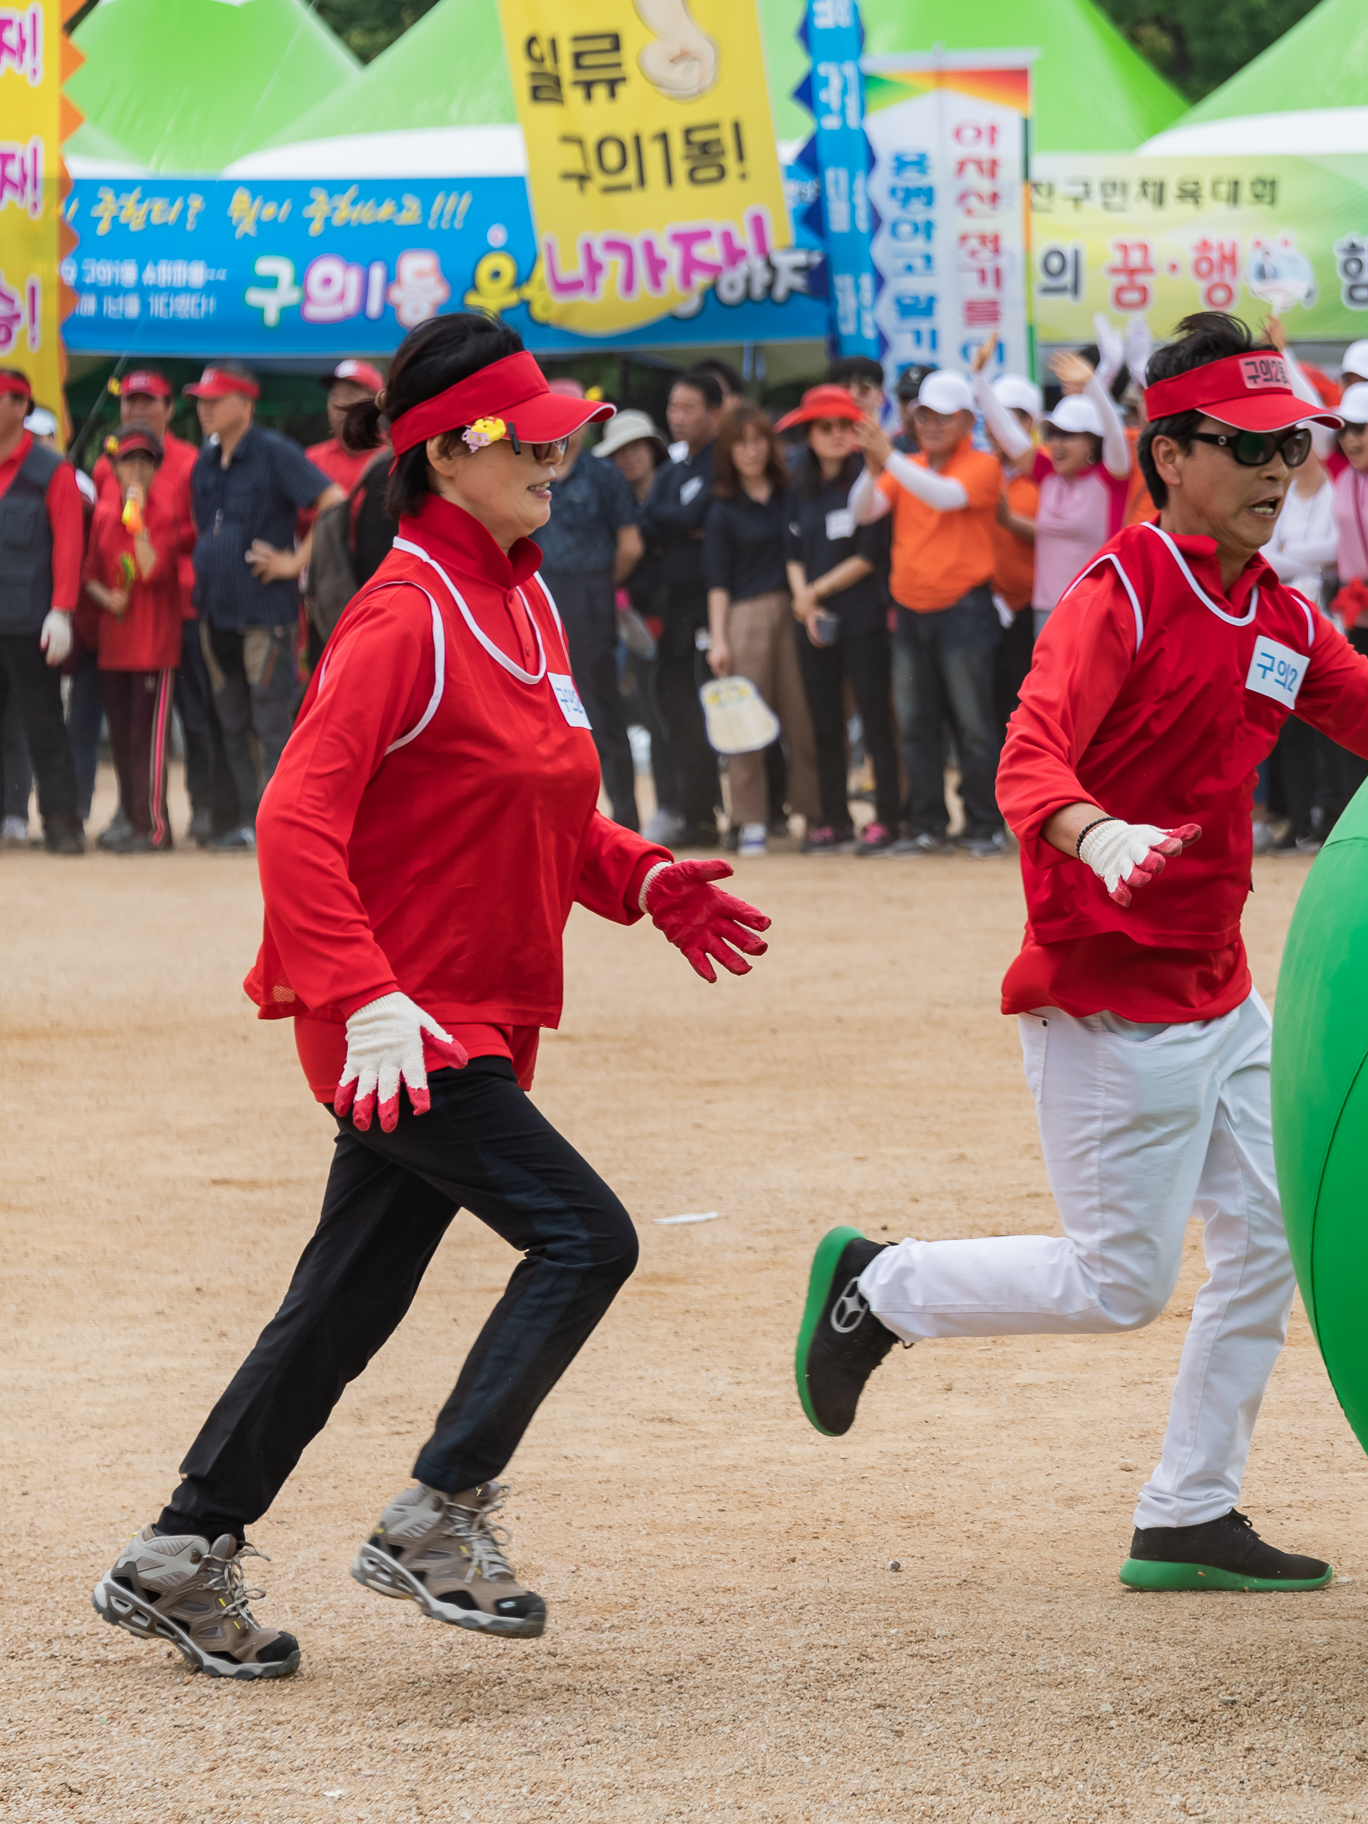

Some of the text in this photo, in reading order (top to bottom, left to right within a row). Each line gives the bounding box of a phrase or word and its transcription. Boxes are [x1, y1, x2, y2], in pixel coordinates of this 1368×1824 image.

[524, 31, 627, 106] 일류
[558, 119, 748, 195] 구의1동!
[544, 208, 772, 300] 나가자!
[1107, 236, 1316, 312] 꿈·행
[1256, 651, 1299, 693] 구의2
